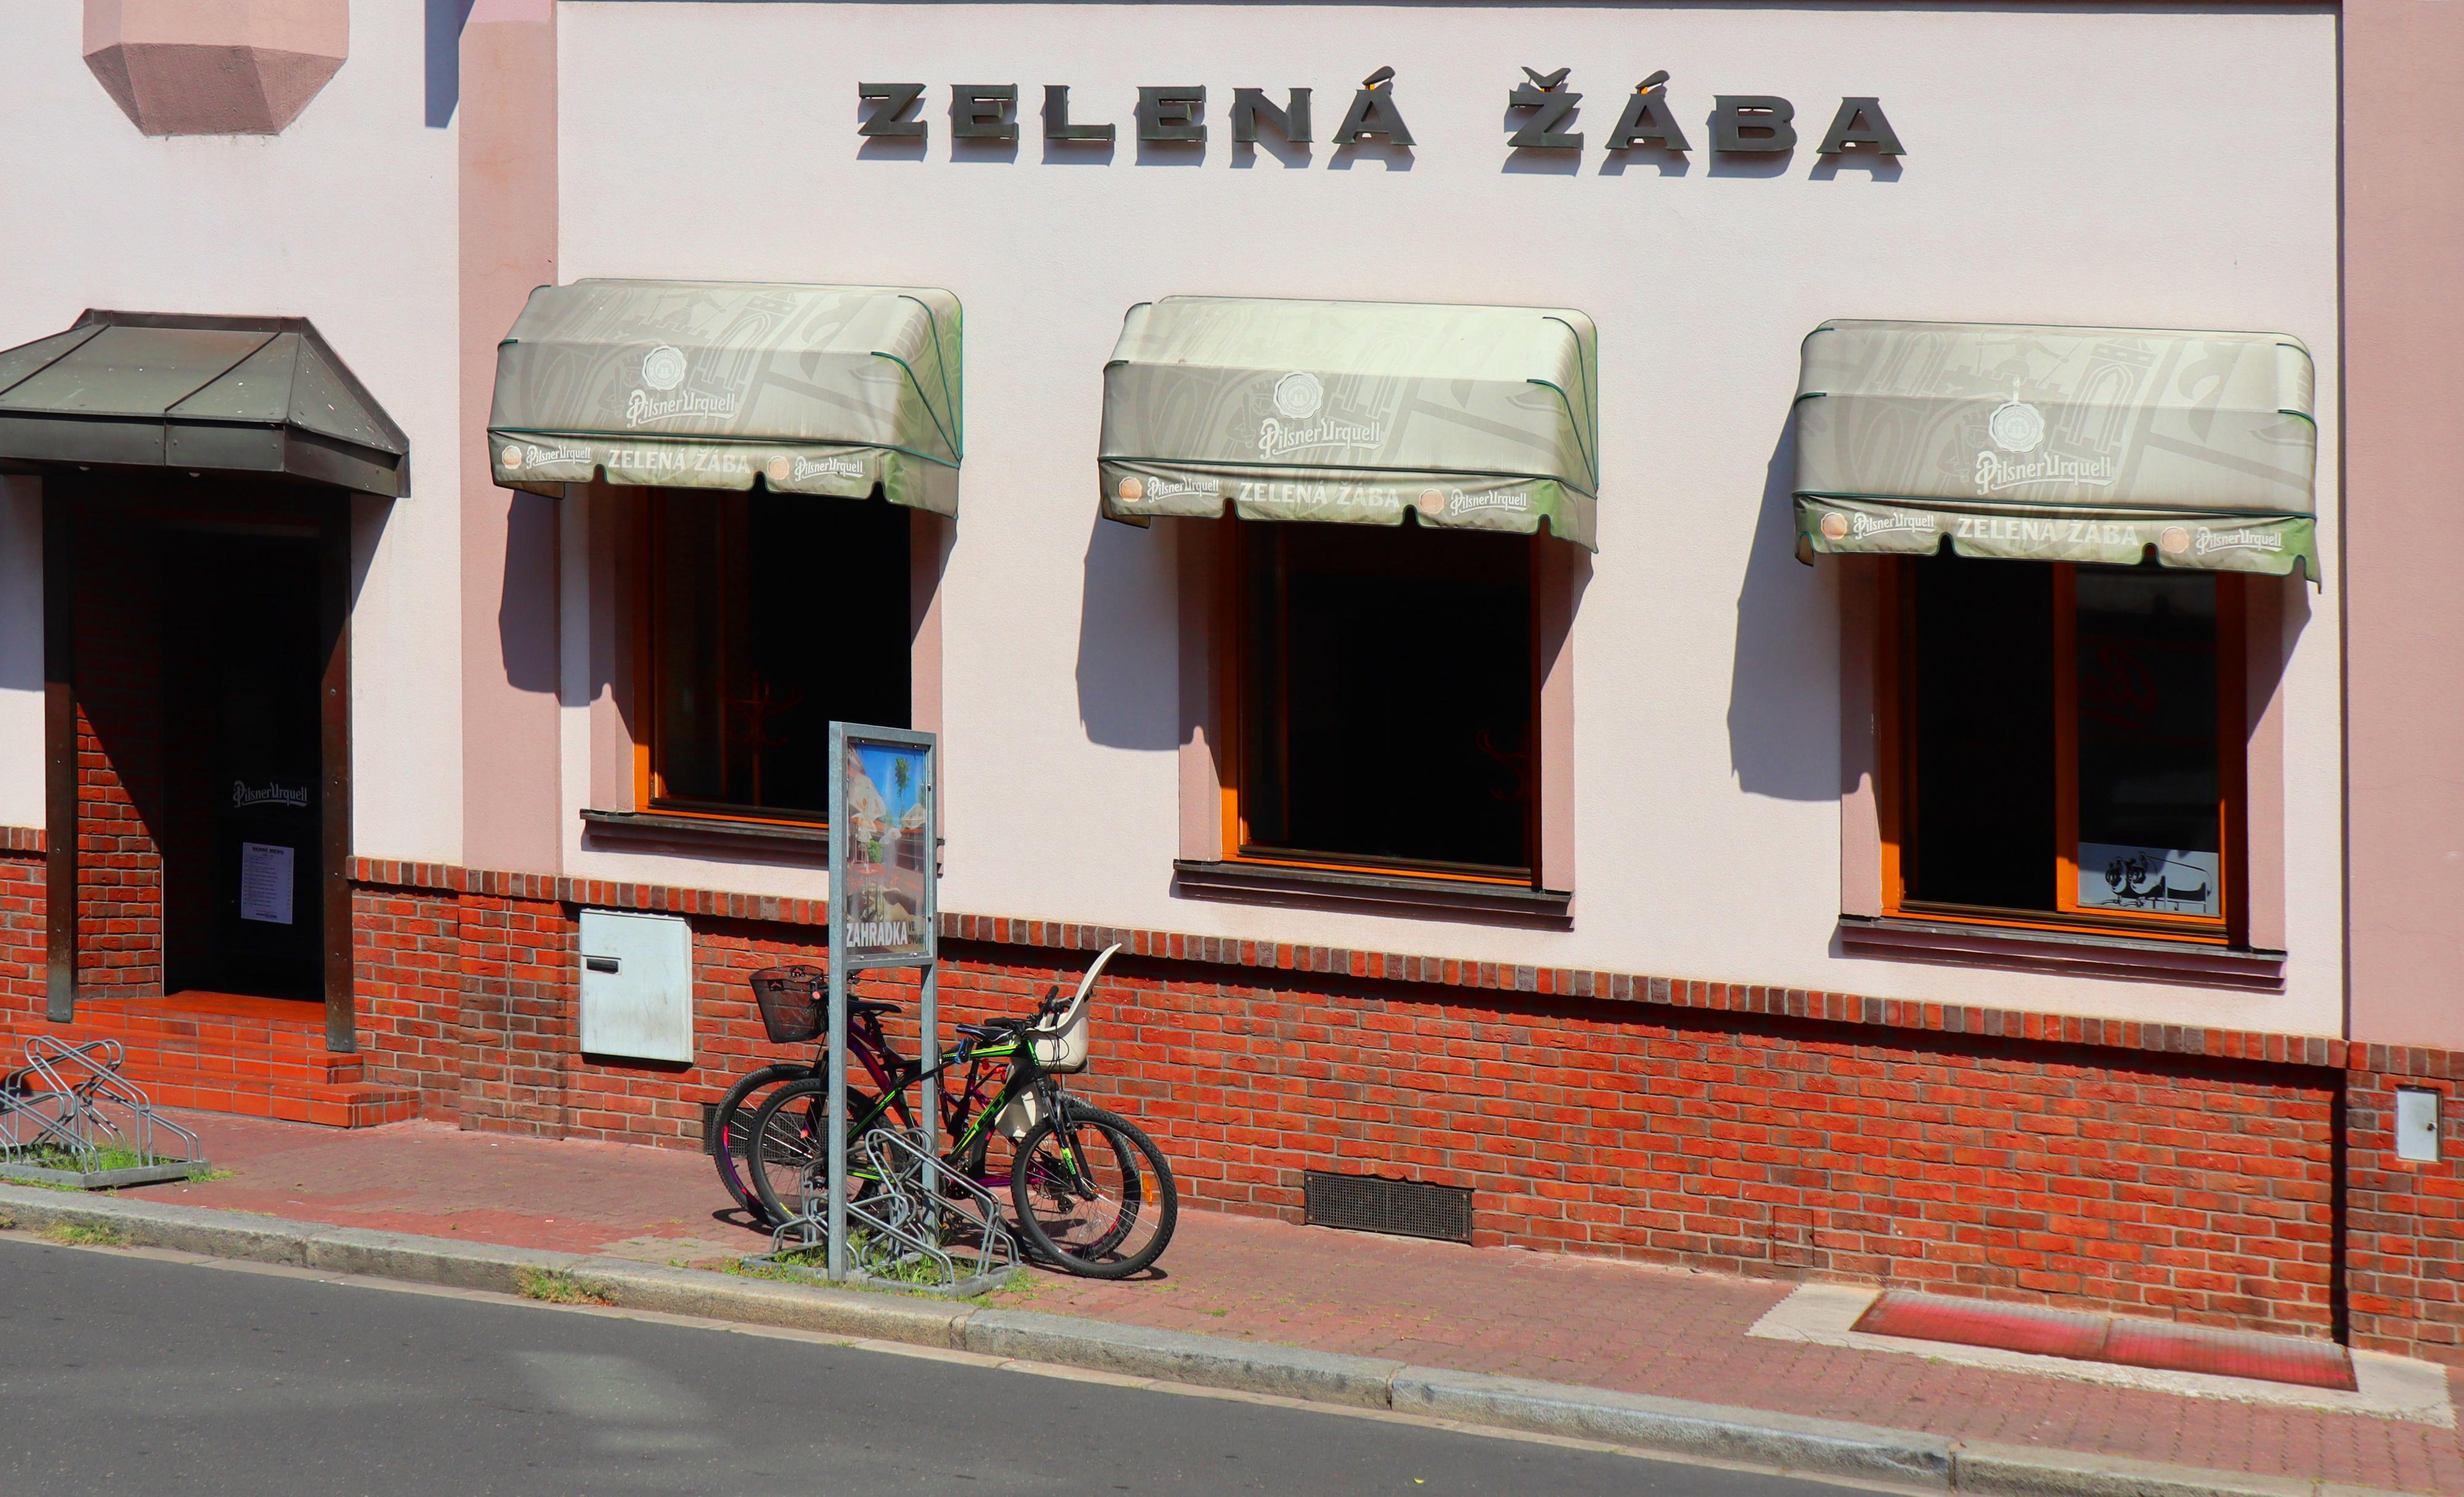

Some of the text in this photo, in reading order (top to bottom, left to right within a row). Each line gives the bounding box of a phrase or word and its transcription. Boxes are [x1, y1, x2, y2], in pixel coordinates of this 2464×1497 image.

[858, 66, 1907, 156] ZELENÁ ŽÁBA
[626, 389, 736, 429] Pilsner Urquell
[1258, 417, 1380, 460] Pilsner Urquell
[526, 444, 591, 469] Pilsner Urquell
[608, 448, 751, 474] ZELENÁ ŽÁBA
[794, 455, 863, 482] Pilsner Urquell
[1974, 450, 2112, 495] Pilsner Urquell
[1147, 476, 1219, 503] Pilsner Urquell
[1239, 480, 1400, 508] ZELENÁ ŽÁBA
[1450, 488, 1526, 516] Pilsner Urquell
[1853, 511, 1934, 540] Pilsner Urquell
[2195, 526, 2282, 556] Pilsner Urquell
[232, 780, 307, 808] Pilsner Urquell
